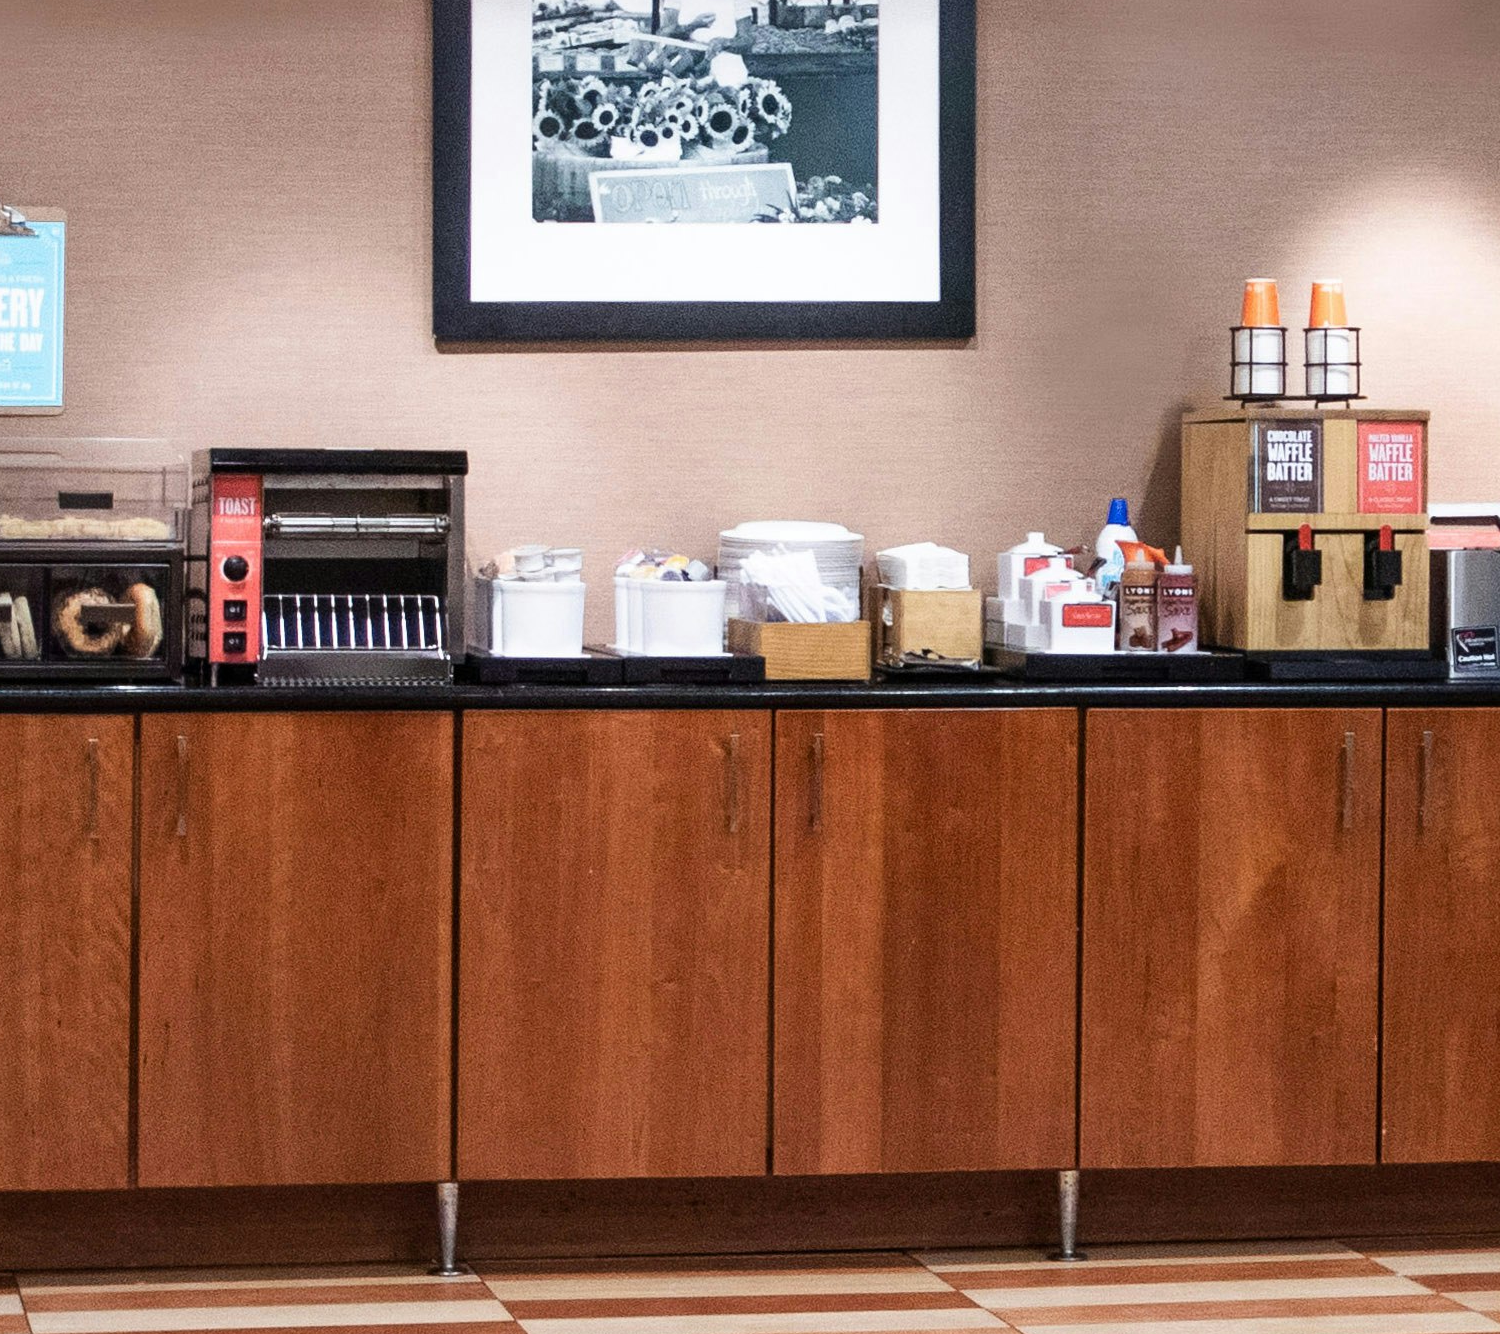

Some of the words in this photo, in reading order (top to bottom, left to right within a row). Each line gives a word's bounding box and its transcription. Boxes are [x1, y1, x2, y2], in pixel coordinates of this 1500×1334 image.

[20, 332, 44, 352] DAY
[1267, 430, 1312, 442] CHOCOLATE
[1267, 443, 1313, 462] WAFFLE
[1368, 444, 1413, 462] WAFFLE
[1267, 463, 1313, 481] BATTER
[1368, 463, 1413, 481] BATTER
[218, 497, 256, 515] TOAST
[1163, 588, 1194, 596] LYONS
